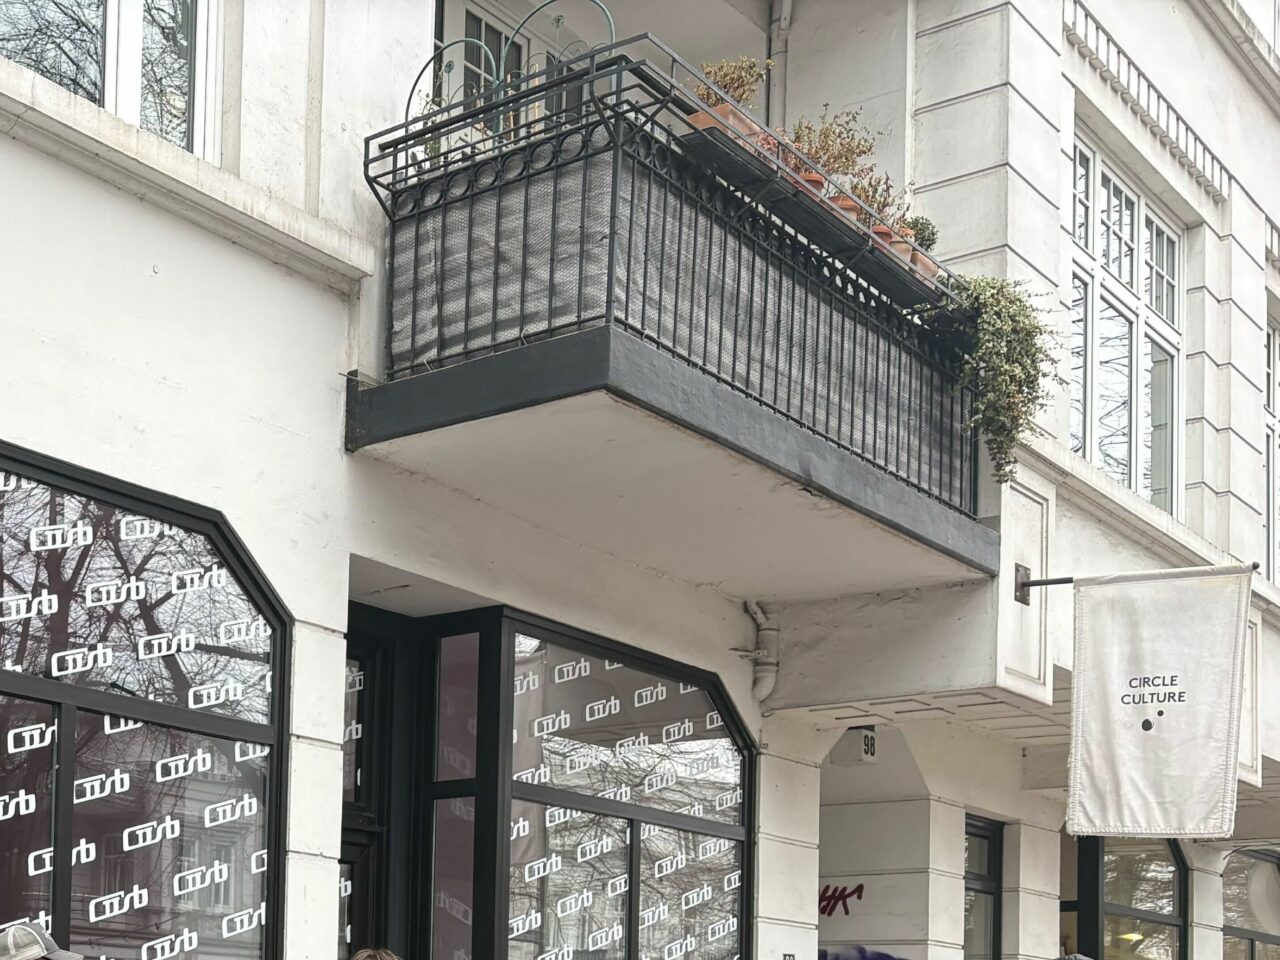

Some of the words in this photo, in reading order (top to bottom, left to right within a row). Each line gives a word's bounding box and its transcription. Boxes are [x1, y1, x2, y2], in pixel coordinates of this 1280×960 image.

[1128, 675, 1179, 689] CIRCLE
[1120, 690, 1186, 706] CULTURE
[863, 734, 876, 757] 98
